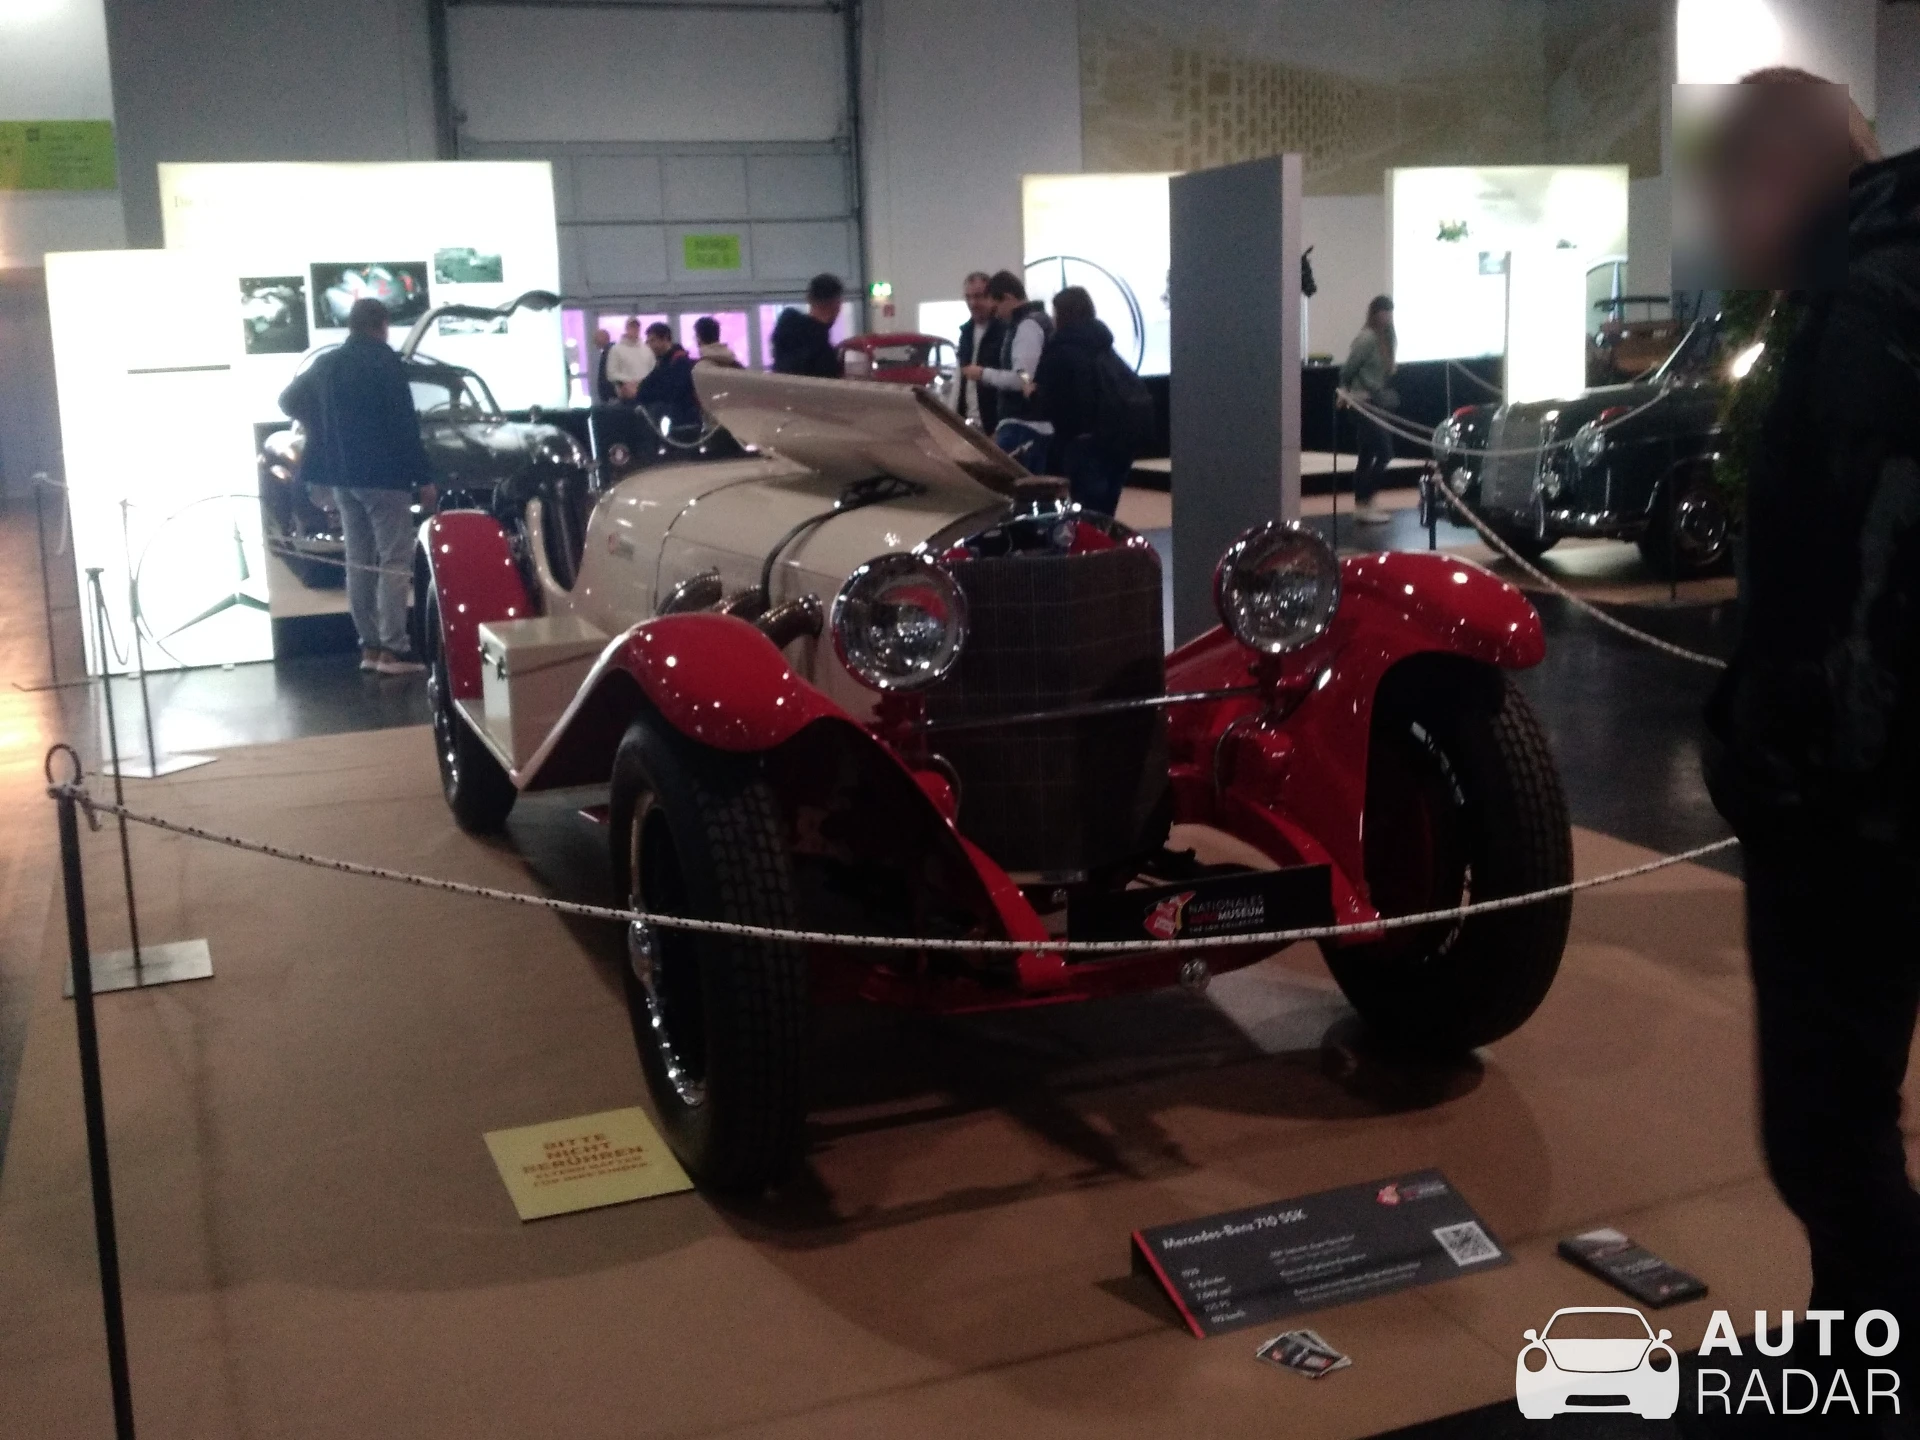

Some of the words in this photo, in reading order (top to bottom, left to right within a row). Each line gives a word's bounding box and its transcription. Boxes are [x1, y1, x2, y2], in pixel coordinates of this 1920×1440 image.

[1189, 895, 1264, 913] NATIONALES
[544, 1133, 606, 1149] BITTE
[546, 1141, 611, 1160] NICHT
[1162, 1223, 1254, 1250] Mercedes-Benz
